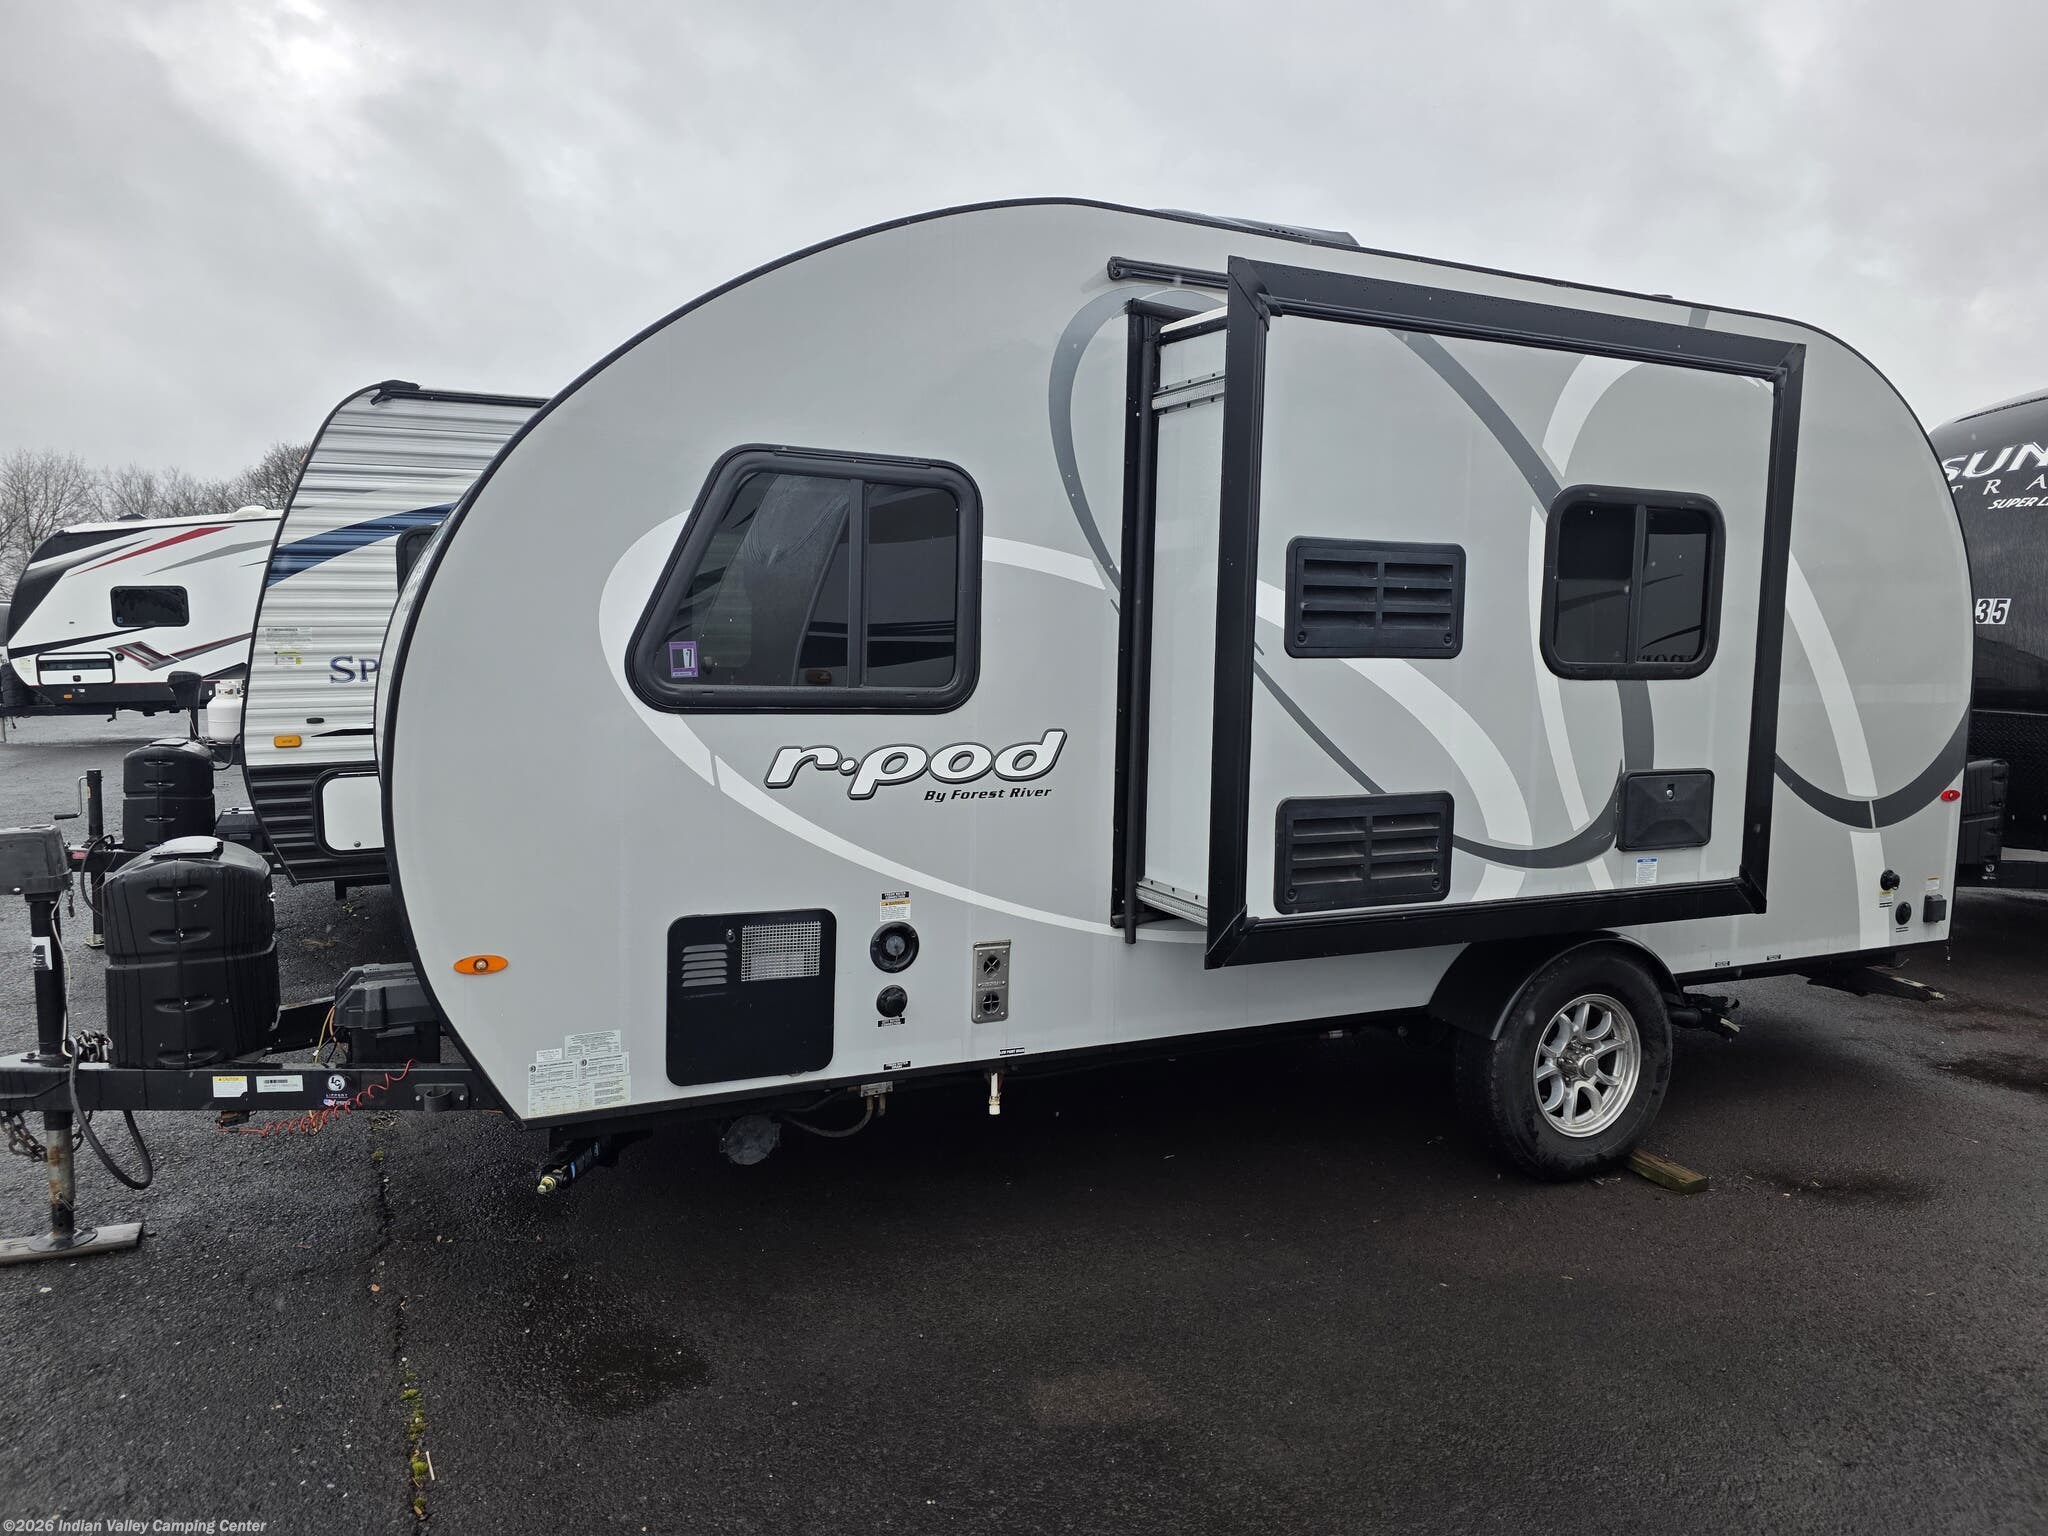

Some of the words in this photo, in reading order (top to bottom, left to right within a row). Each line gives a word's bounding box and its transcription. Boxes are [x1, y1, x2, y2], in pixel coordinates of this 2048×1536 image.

[1987, 497, 2038, 509] SUPER
[1976, 599, 2008, 624] 35
[329, 655, 380, 684] SP
[924, 790, 947, 803] By
[951, 789, 1006, 800] Forest
[1009, 787, 1053, 798] River
